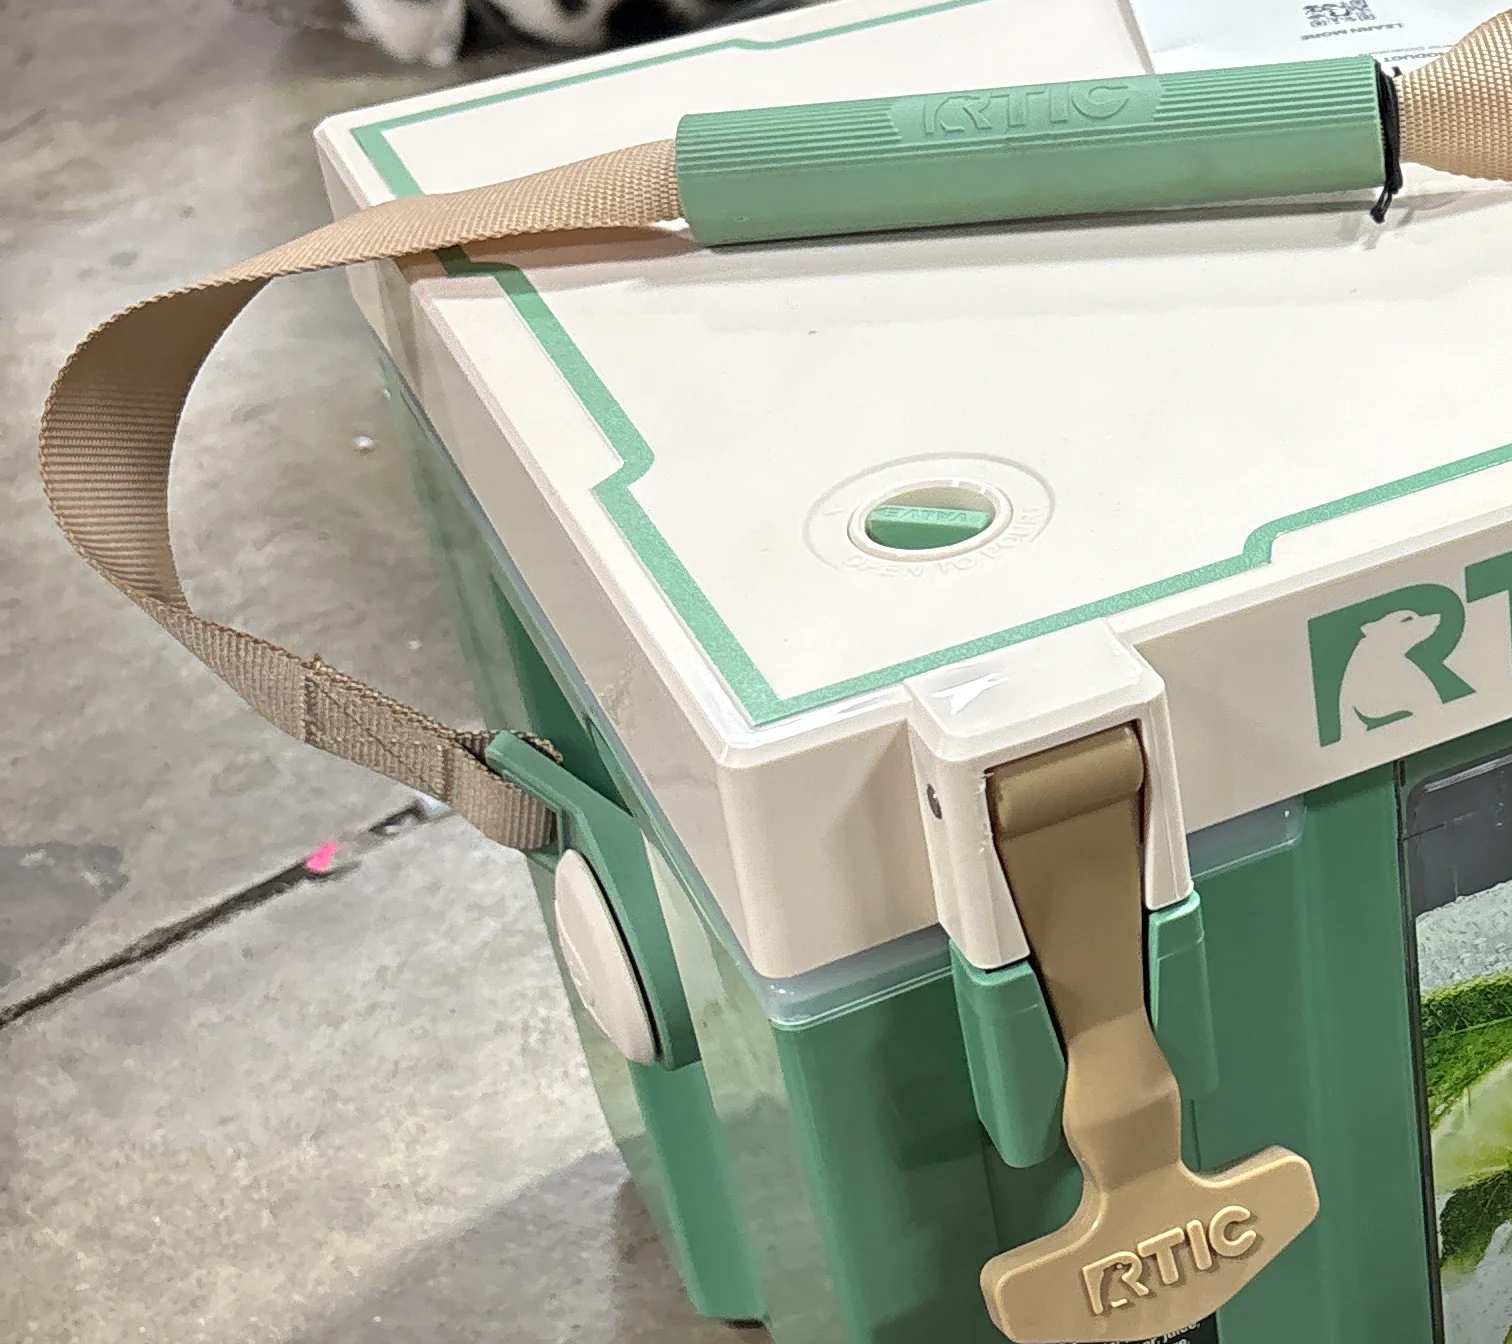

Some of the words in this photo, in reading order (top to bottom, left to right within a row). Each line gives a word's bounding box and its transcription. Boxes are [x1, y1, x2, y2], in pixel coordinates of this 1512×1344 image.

[1383, 51, 1444, 62] ODUCT
[922, 84, 1130, 136] RTIC
[1081, 1205, 1258, 1315] RTIC
